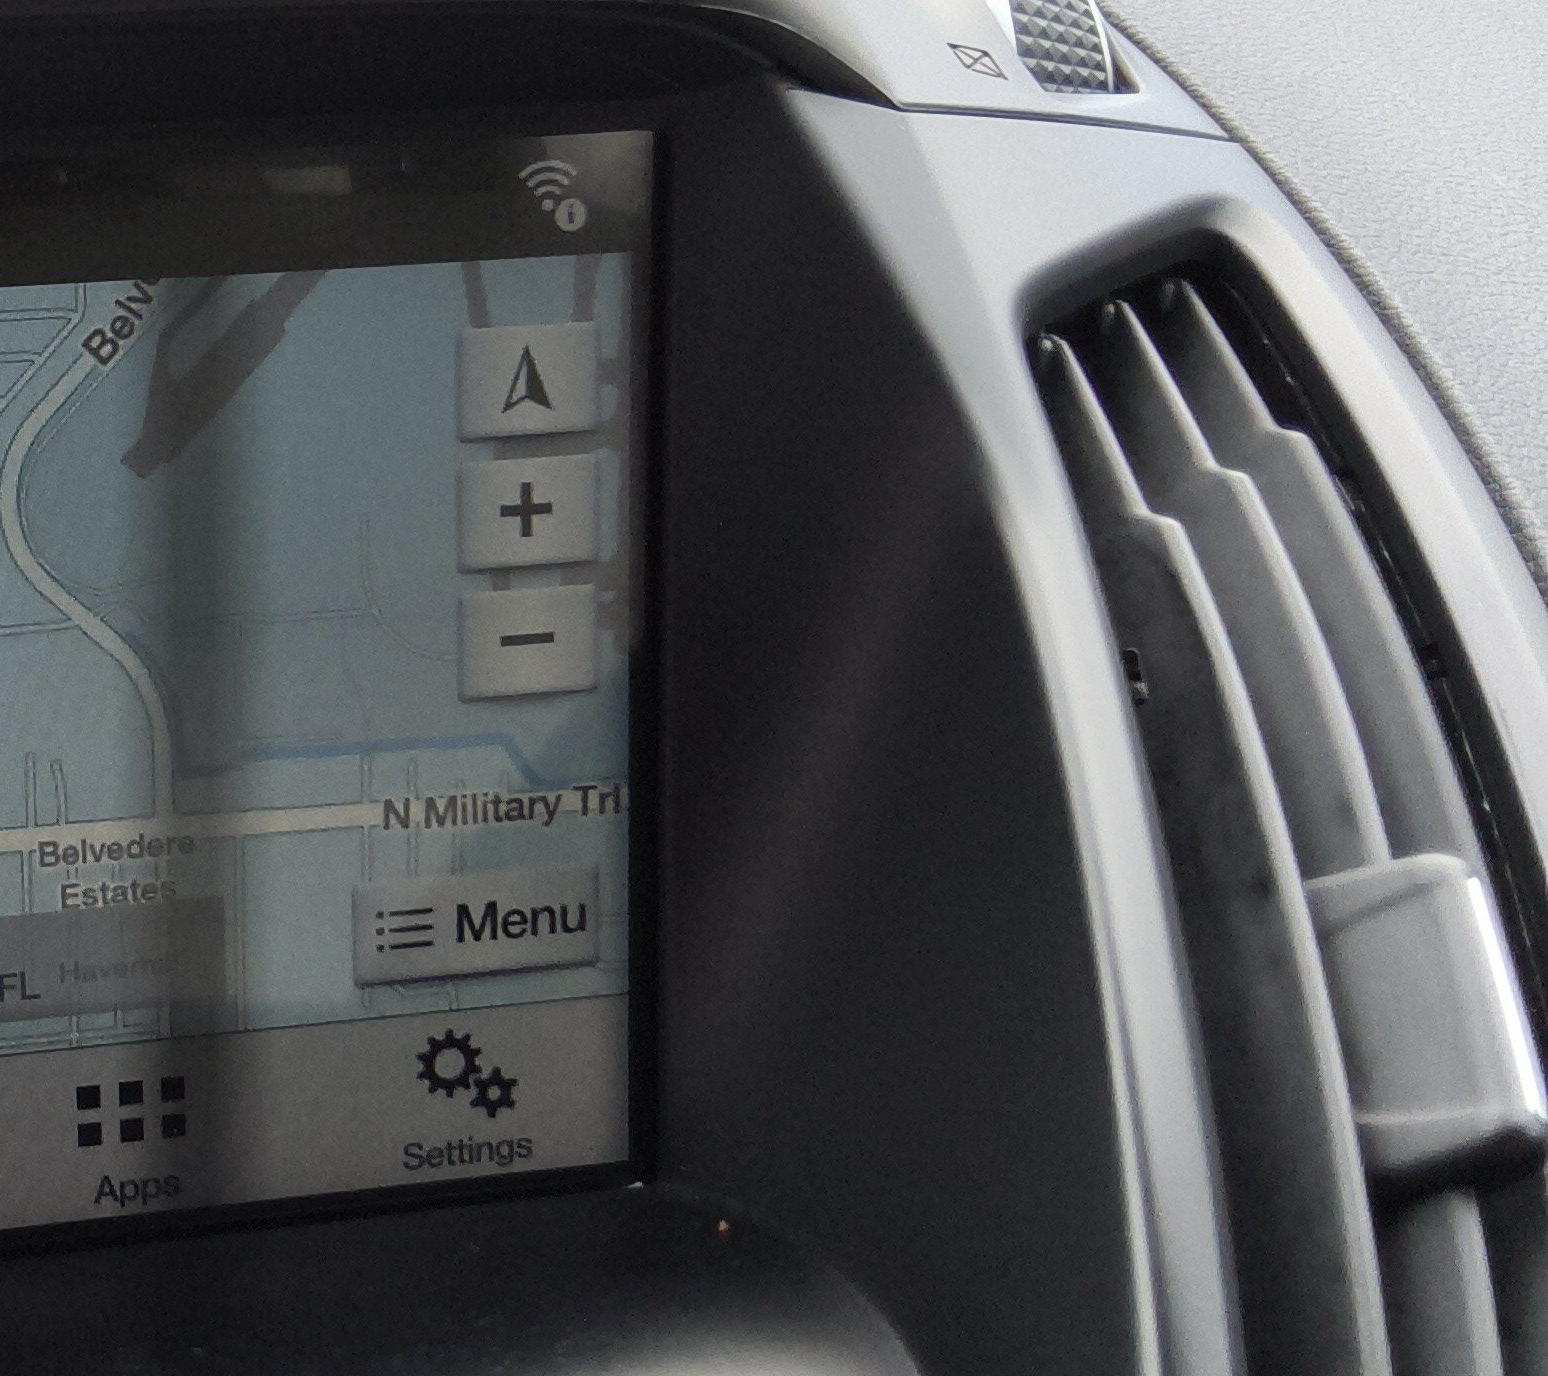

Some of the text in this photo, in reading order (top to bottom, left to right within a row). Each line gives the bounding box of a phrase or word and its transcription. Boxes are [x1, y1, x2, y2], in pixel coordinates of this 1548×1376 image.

[80, 279, 161, 366] Belv
[382, 784, 622, 831] N Military Trl
[37, 832, 196, 870] Belvedere
[60, 878, 179, 911] Estates
[455, 899, 589, 945] Menu
[402, 1134, 534, 1172] Settings
[94, 1172, 183, 1208] Apps
